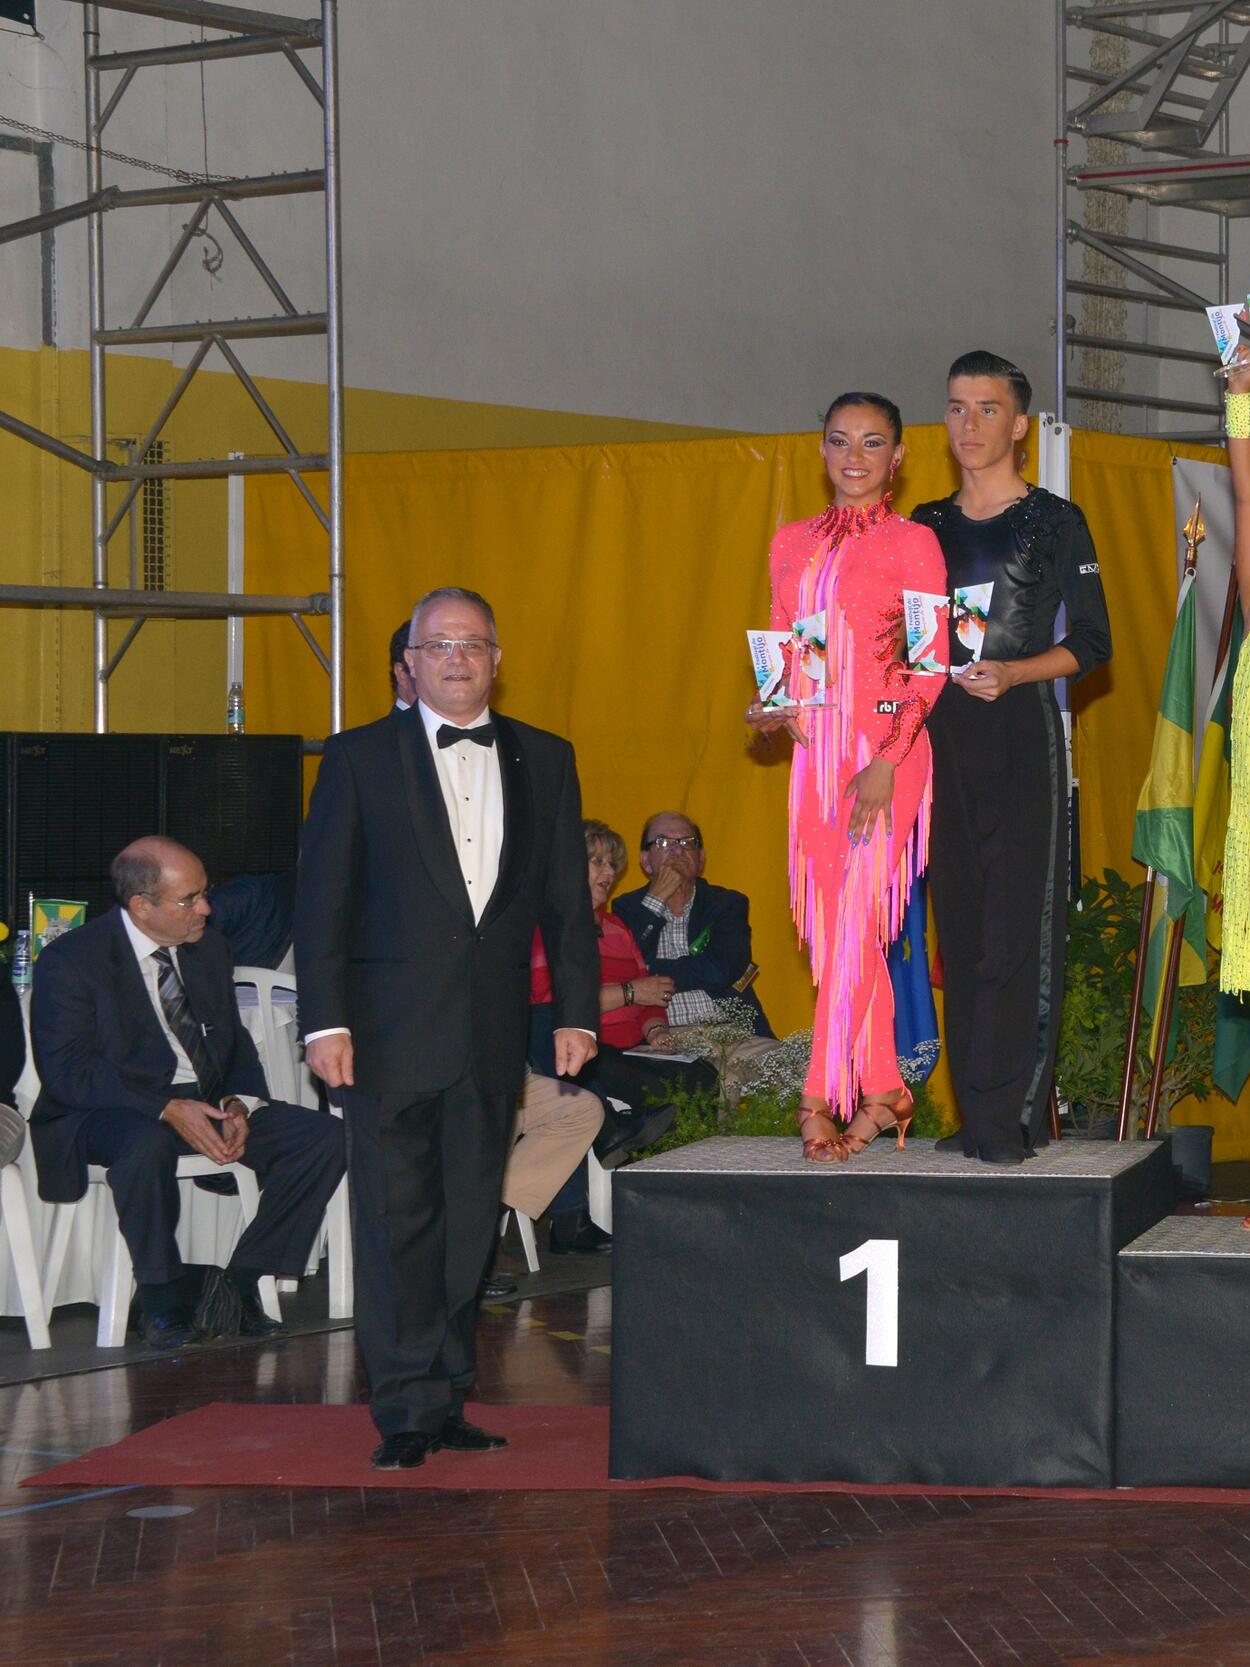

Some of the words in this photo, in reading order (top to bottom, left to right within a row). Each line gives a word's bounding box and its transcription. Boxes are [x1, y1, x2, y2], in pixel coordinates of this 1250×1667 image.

[1214, 311, 1227, 341] Montijo
[912, 597, 921, 634] Montijo
[756, 636, 768, 673] Montijo
[839, 1239, 899, 1367] 1
